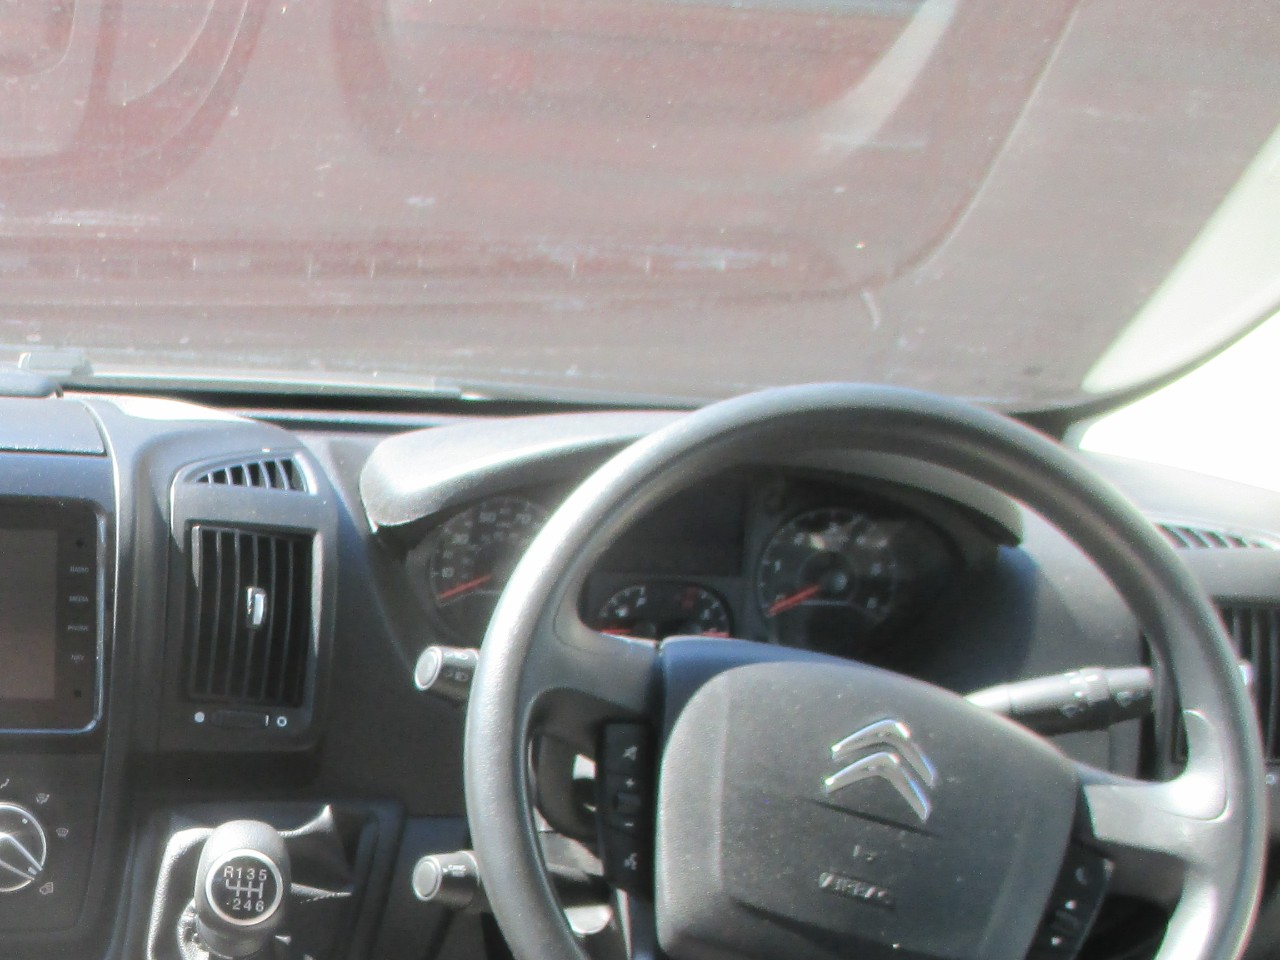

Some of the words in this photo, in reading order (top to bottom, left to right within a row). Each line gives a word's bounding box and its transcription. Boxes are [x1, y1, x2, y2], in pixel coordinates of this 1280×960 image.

[224, 865, 234, 878] R
[236, 867, 242, 879] 1
[246, 868, 255, 880] 3
[259, 869, 267, 881] 5
[232, 899, 241, 910] 2
[243, 900, 252, 911] 4
[255, 900, 265, 912] 6
